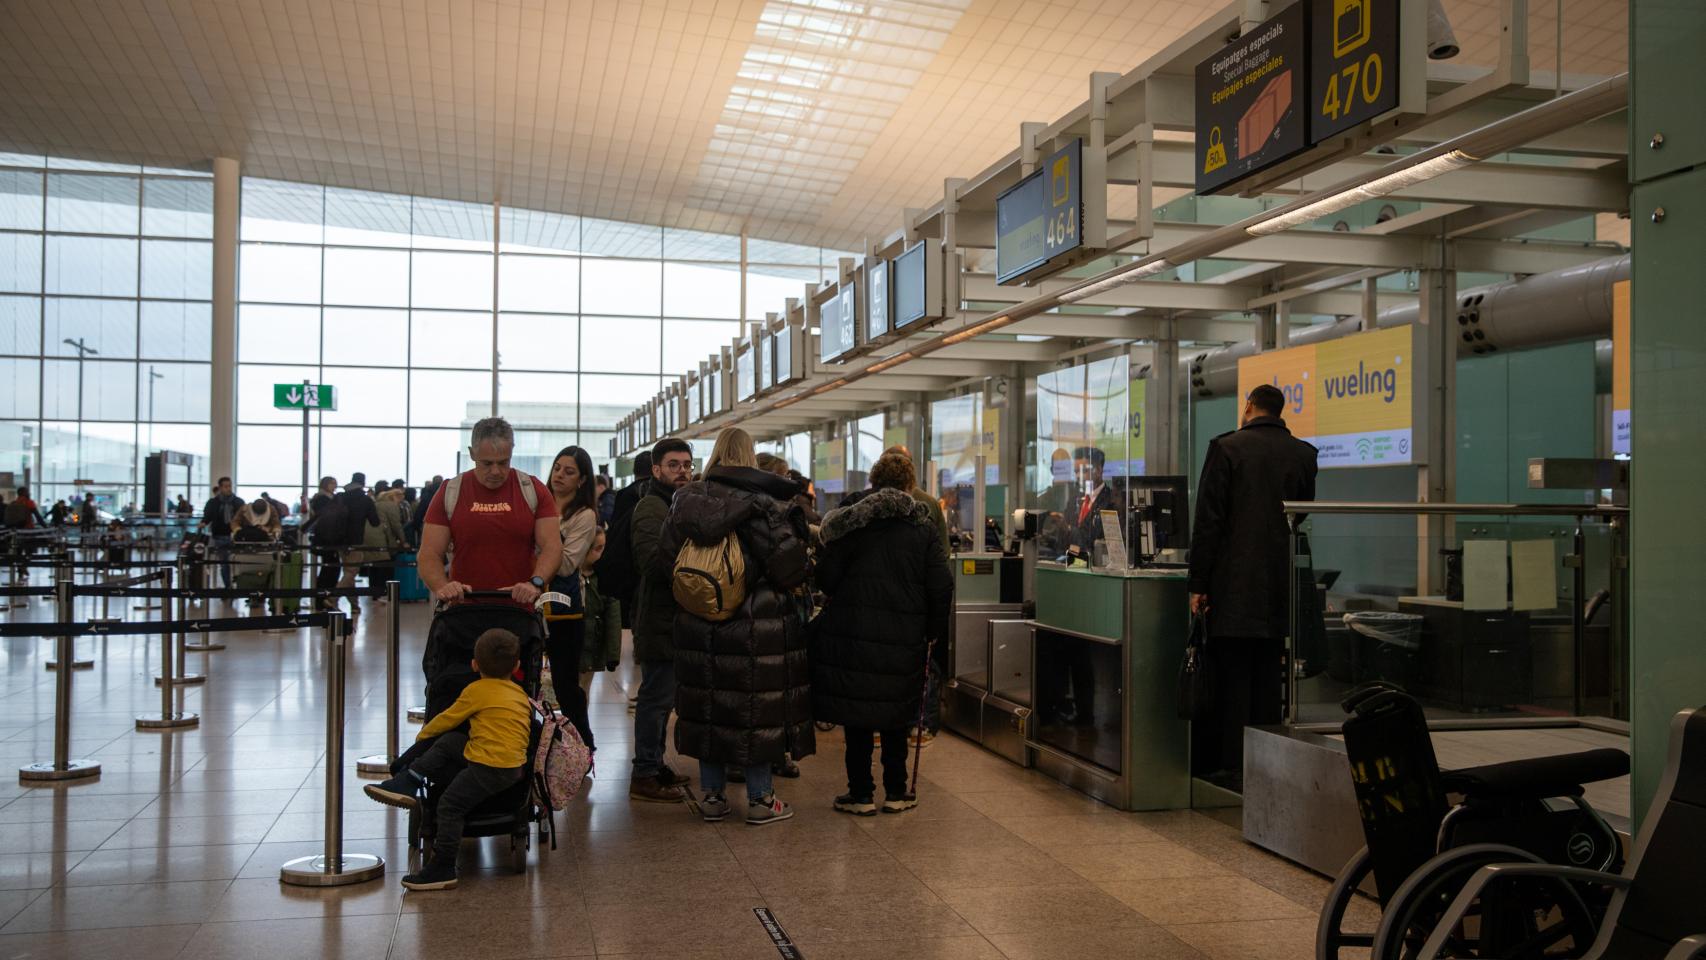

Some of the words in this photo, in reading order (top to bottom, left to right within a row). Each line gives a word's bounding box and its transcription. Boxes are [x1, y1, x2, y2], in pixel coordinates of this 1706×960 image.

[1212, 46, 1248, 75] Equipatges
[1249, 23, 1283, 51] especials
[1212, 79, 1244, 105] Equipajes
[1245, 55, 1283, 85] especiales
[1322, 53, 1383, 121] 470
[1047, 207, 1075, 249] 464
[1325, 360, 1396, 403] vueling
